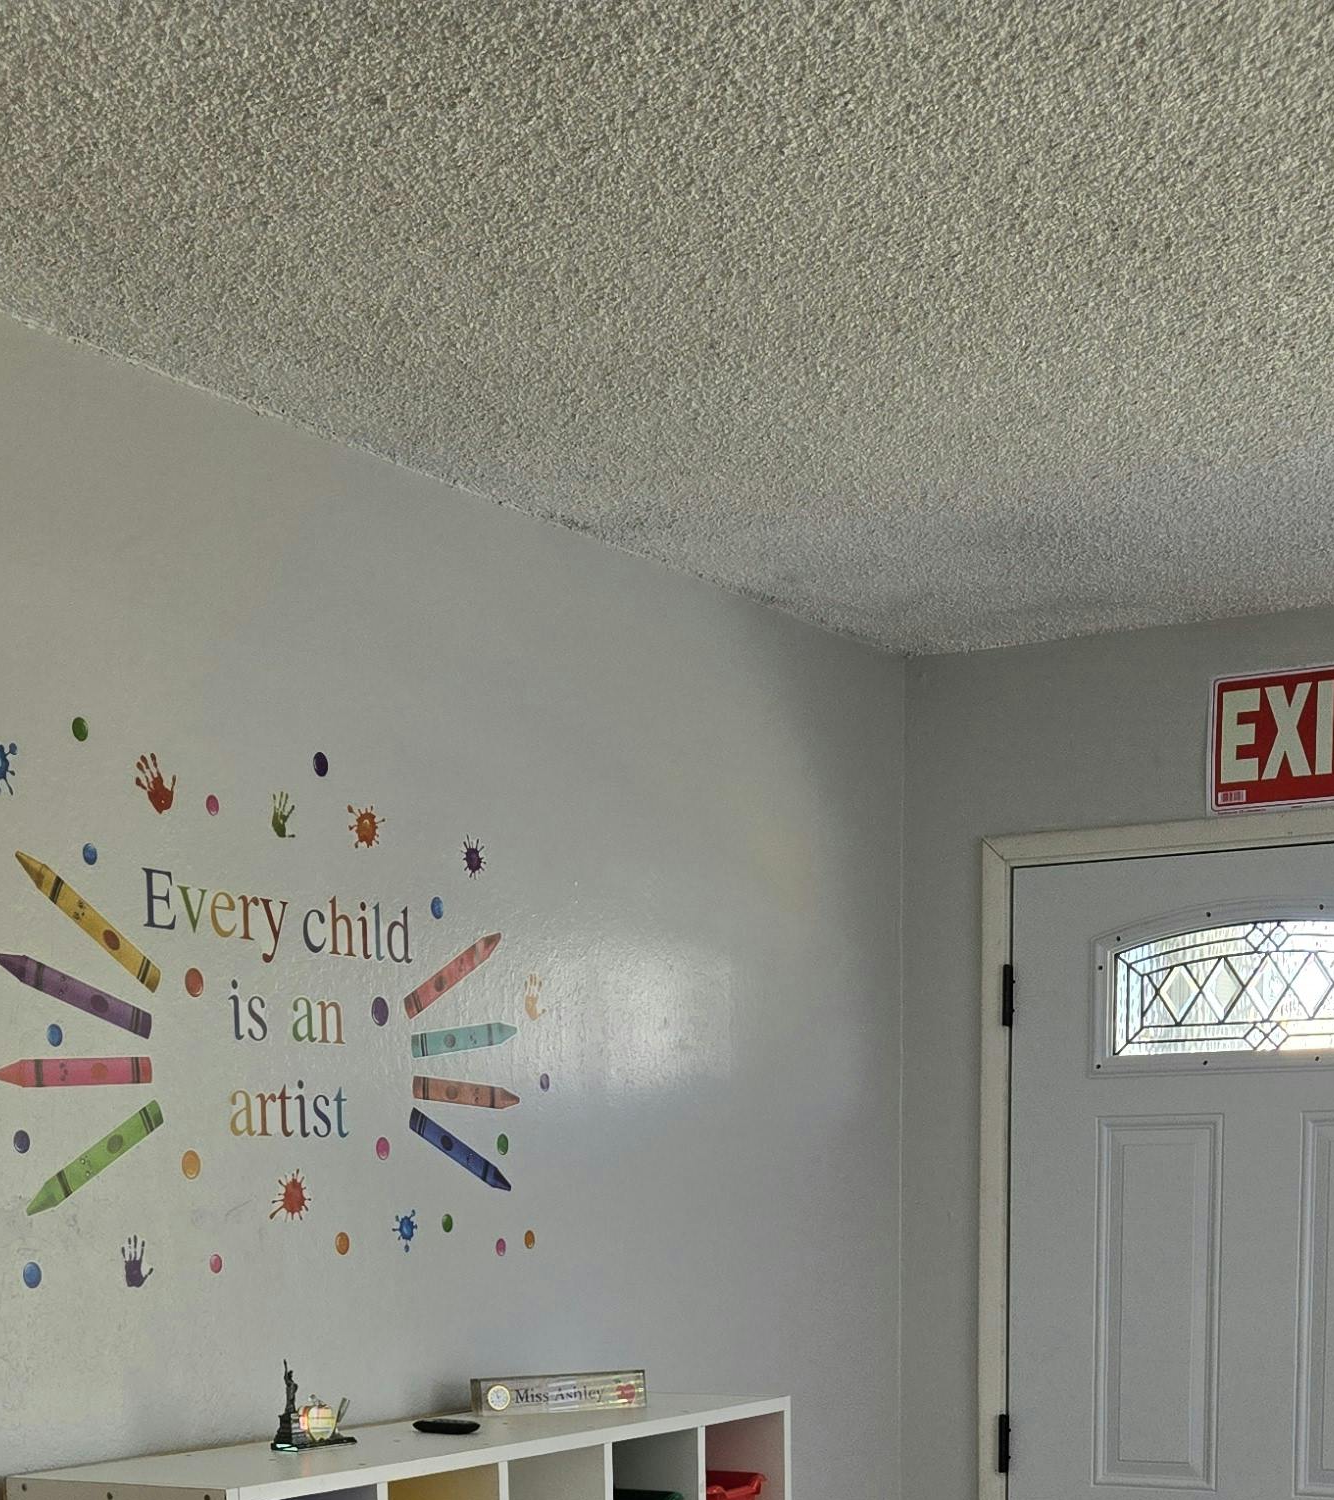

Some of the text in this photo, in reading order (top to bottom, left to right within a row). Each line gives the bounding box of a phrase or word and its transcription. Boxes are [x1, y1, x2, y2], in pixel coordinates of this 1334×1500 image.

[141, 867, 413, 964] Every child
[228, 979, 346, 1044] is an
[229, 1079, 349, 1138] artist
[515, 1388, 550, 1404] Miss
